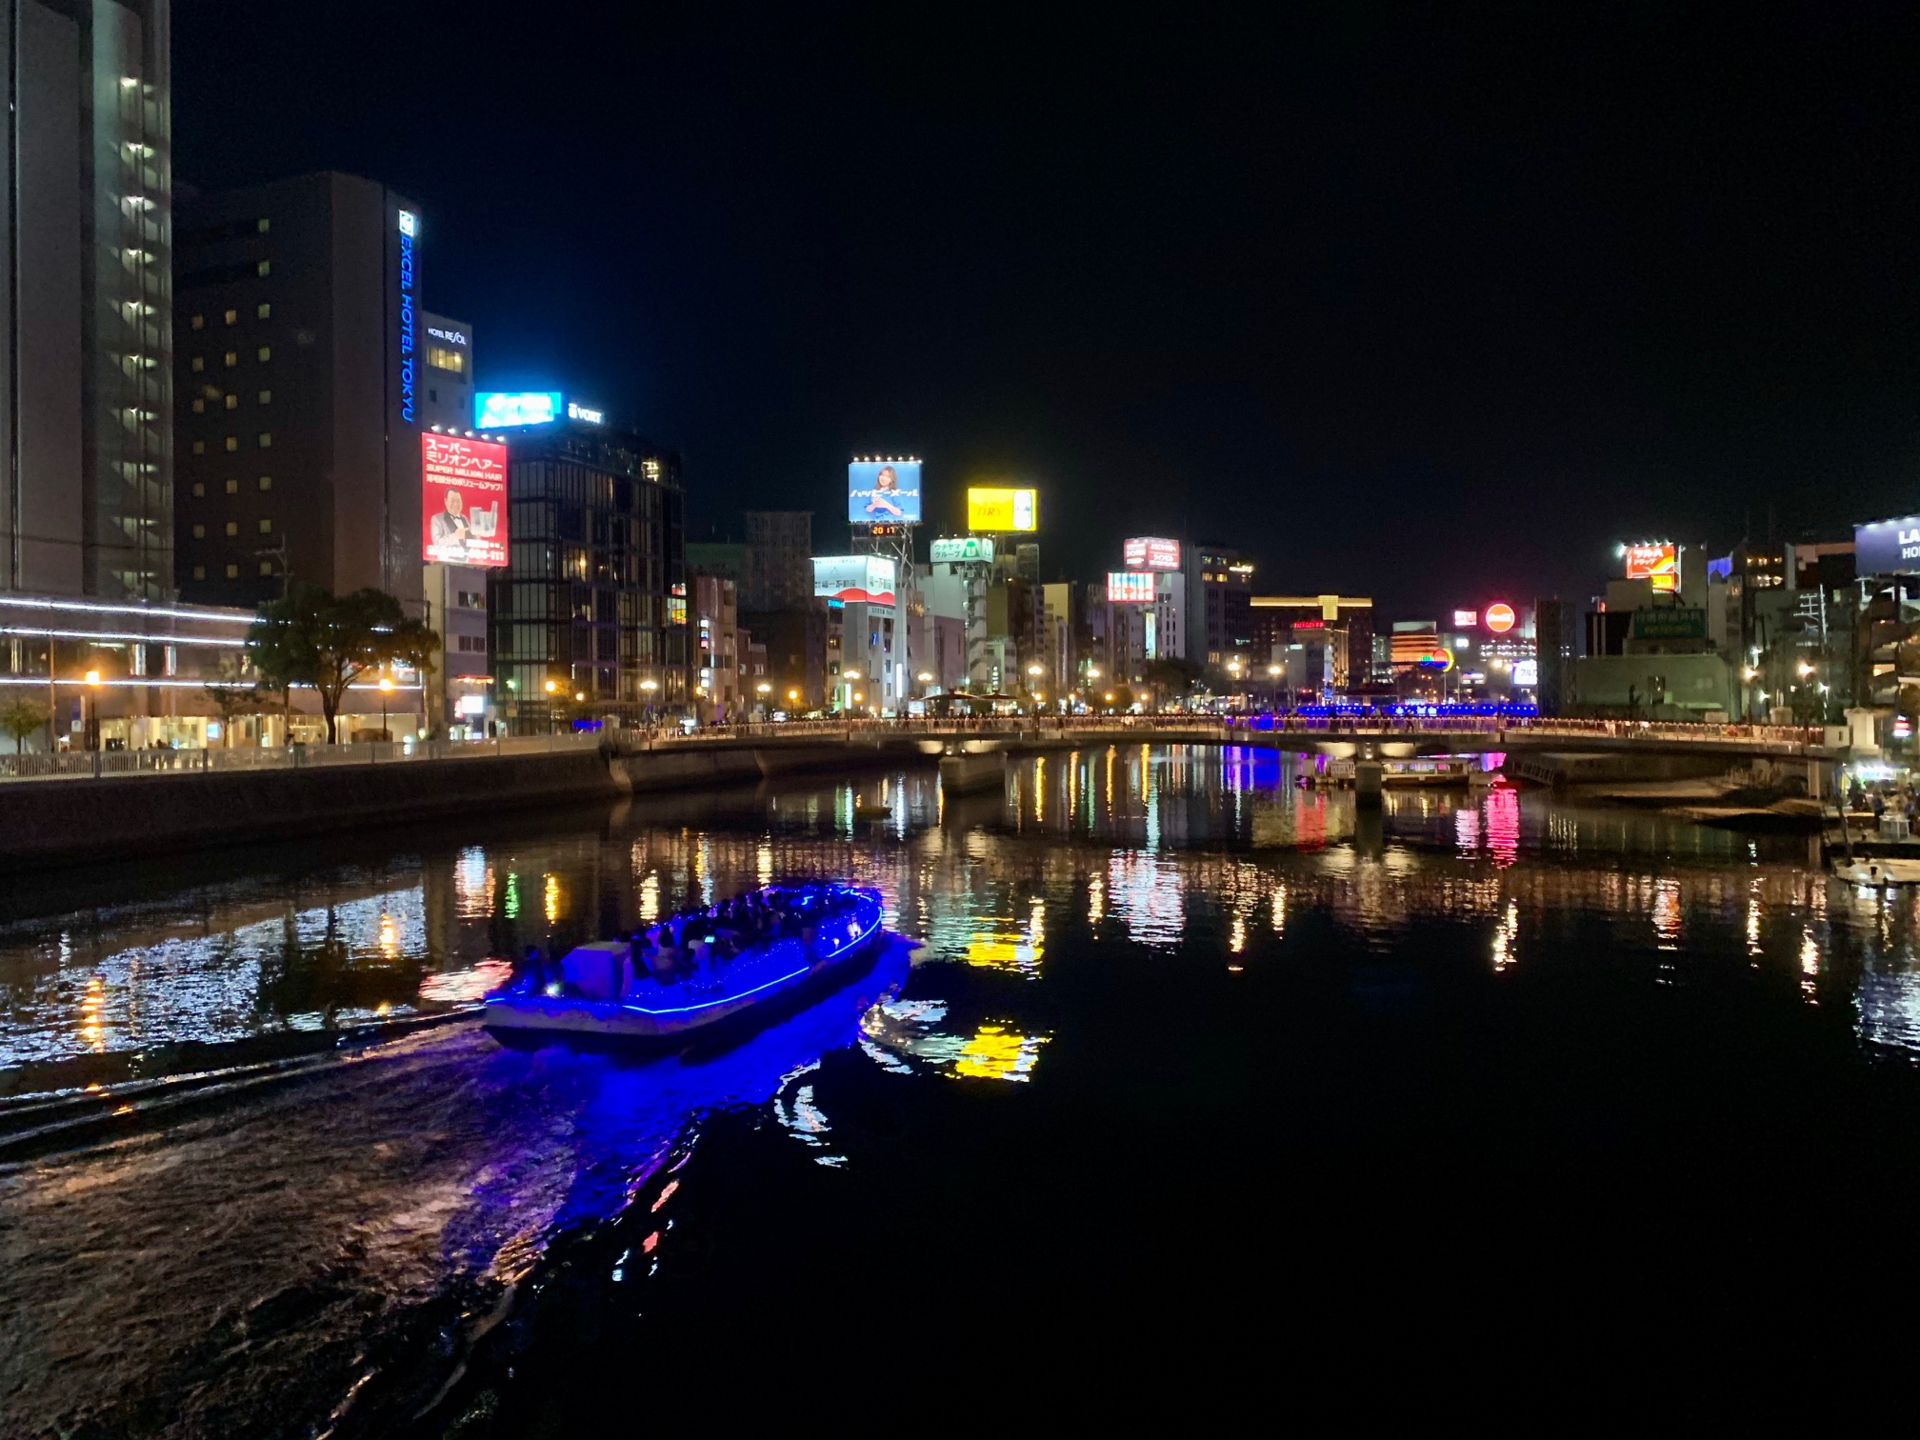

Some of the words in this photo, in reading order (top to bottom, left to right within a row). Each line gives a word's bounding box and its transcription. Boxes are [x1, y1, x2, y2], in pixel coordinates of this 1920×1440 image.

[401, 234, 412, 290] EXCEL
[401, 293, 413, 355] HOTEL
[428, 328, 445, 339] HOTEL
[445, 331, 467, 345] RESOL
[402, 358, 413, 422] TOKYU
[577, 407, 602, 424] VORT
[426, 438, 471, 454] スーパー
[426, 450, 503, 470] ミリオンヘアー
[426, 463, 453, 473] SUPER
[455, 467, 484, 478] MILLION
[485, 472, 503, 481] HAIR
[850, 489, 919, 498] ハッピーメール
[934, 543, 961, 551] ウチヤマ
[934, 551, 961, 559] グループ
